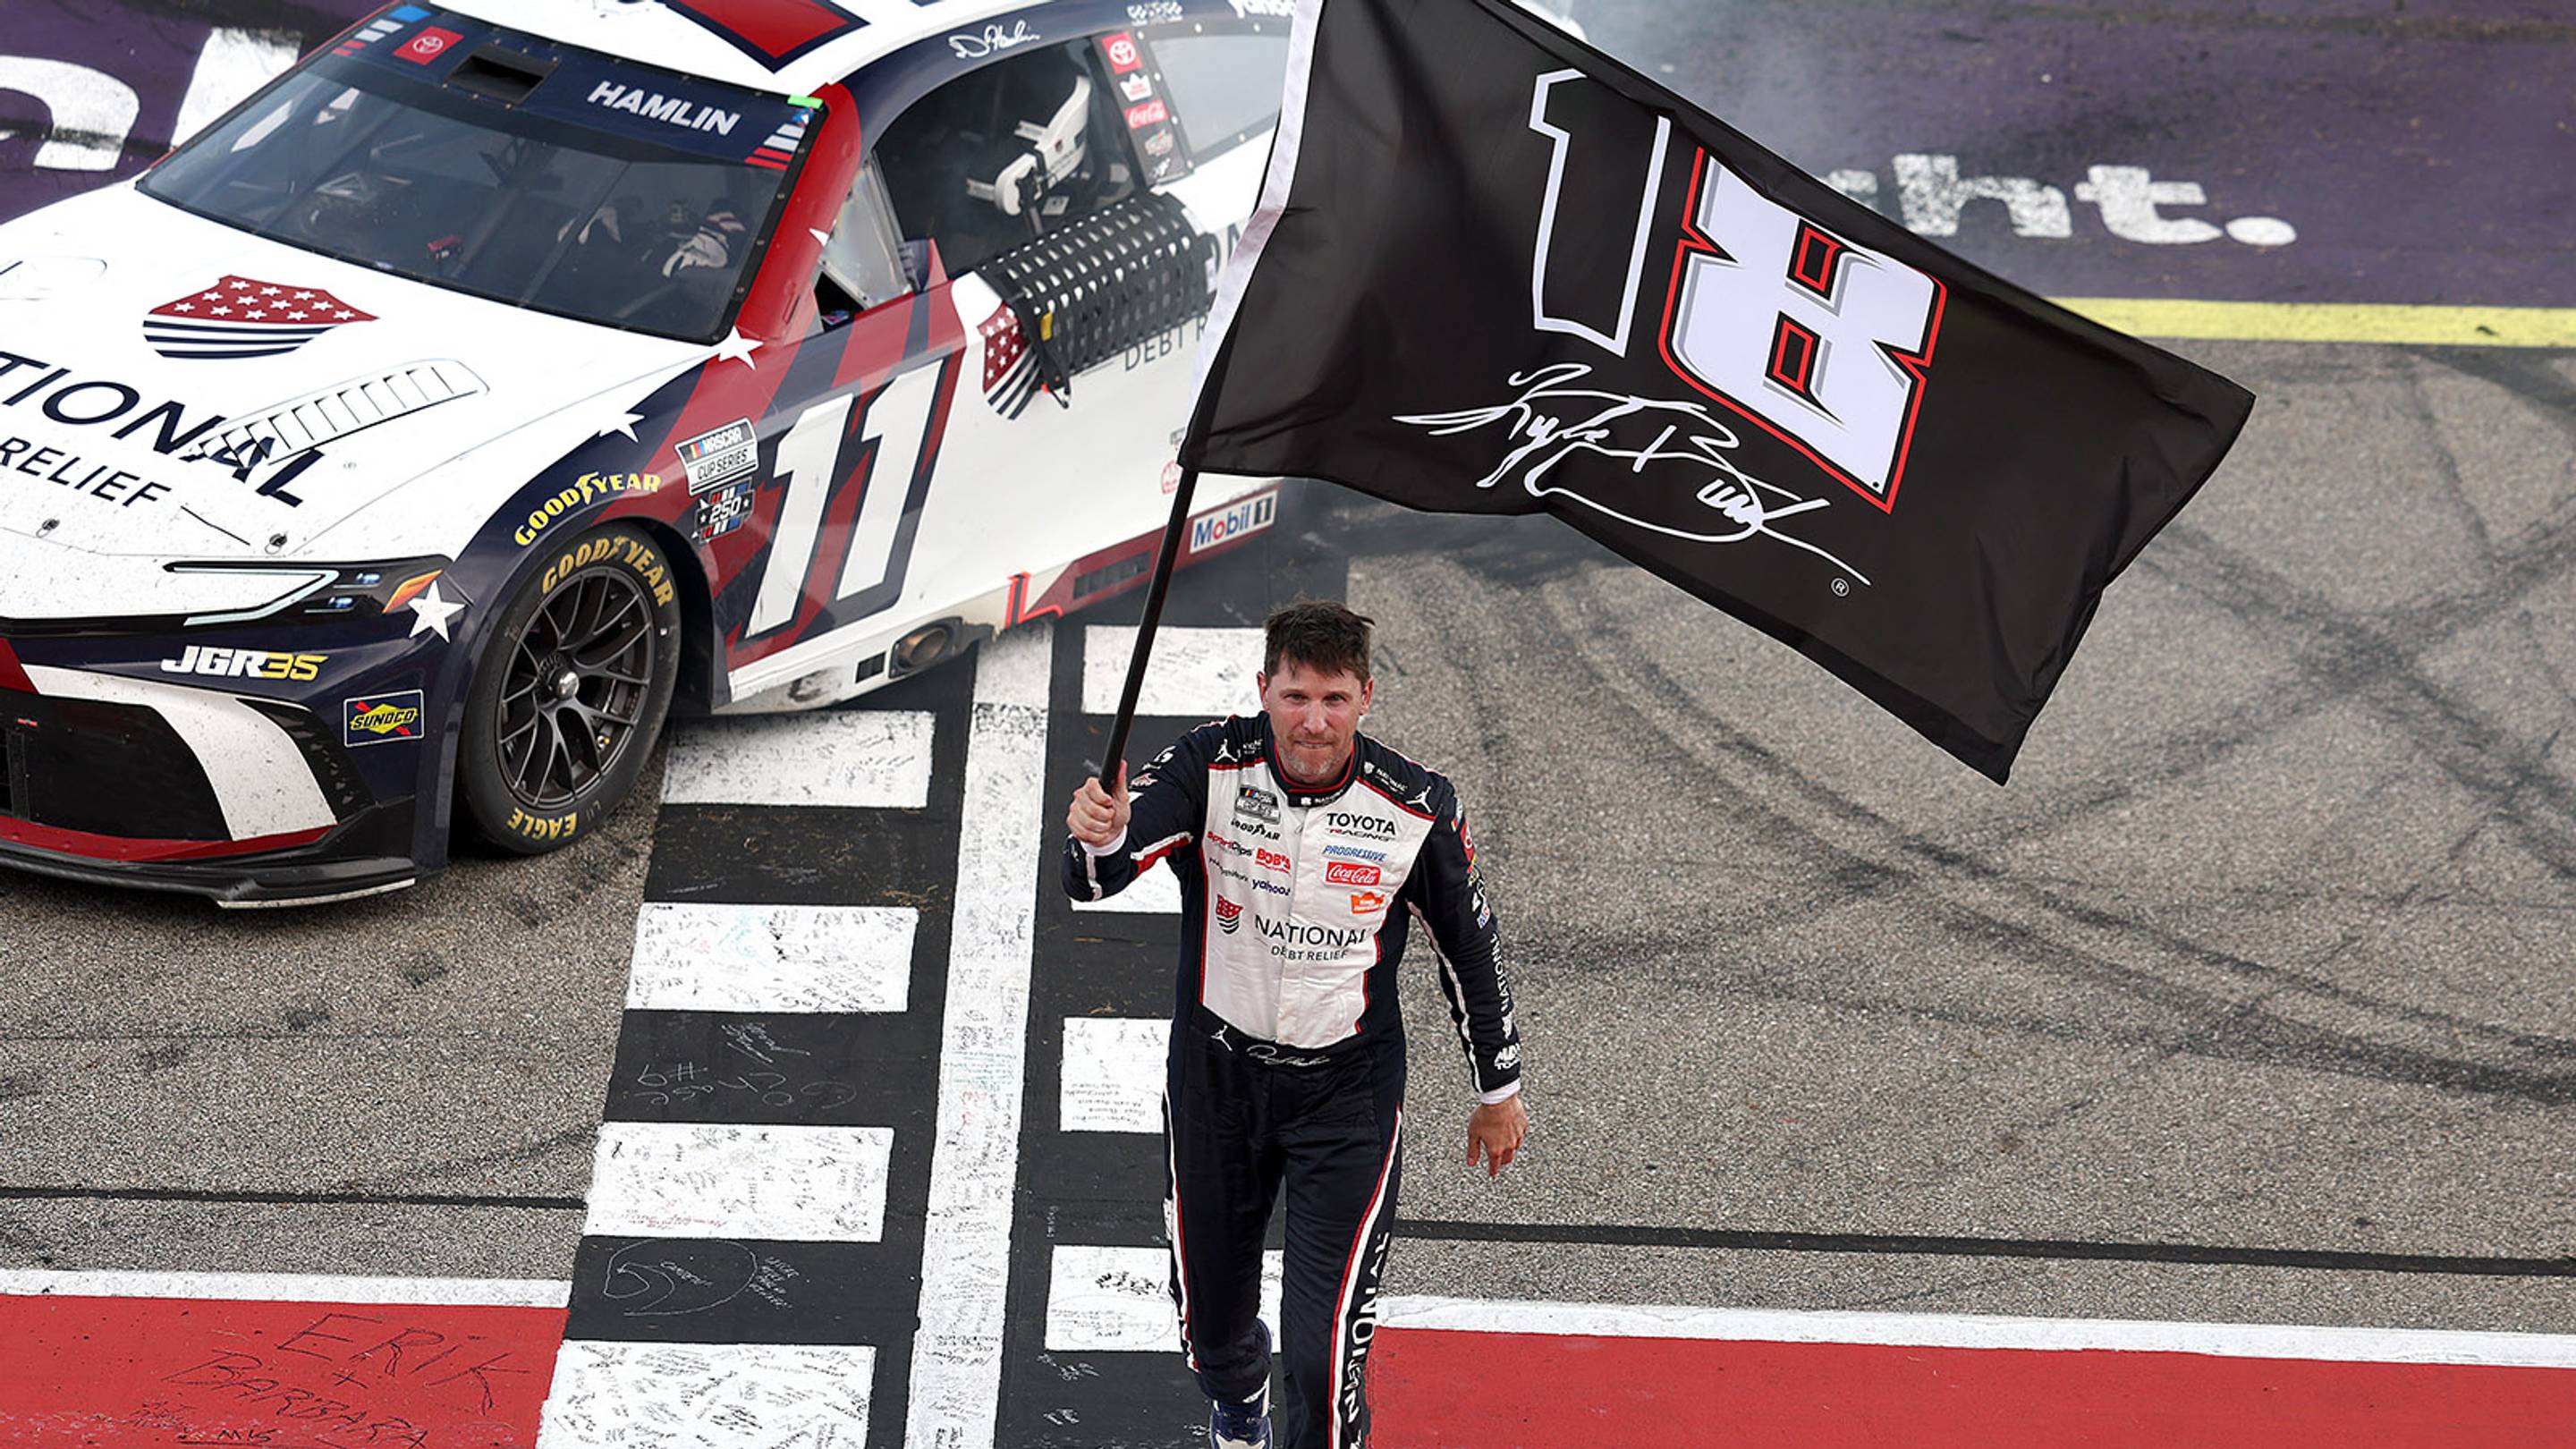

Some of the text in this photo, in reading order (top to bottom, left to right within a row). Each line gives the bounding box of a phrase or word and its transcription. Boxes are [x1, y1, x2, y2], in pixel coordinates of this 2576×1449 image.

[588, 80, 740, 137] HAMLIN
[1528, 68, 1947, 514] 18
[702, 426, 743, 454] NASCAR
[0, 436, 172, 507] RELIEF
[698, 448, 748, 480] CUP SERIES
[514, 471, 662, 547] GOODYEAR
[709, 496, 742, 523] 250
[744, 359, 944, 640] 11
[1193, 496, 1274, 548] Mobil 1
[542, 536, 675, 607] GOODYEAR
[352, 709, 417, 730] SUNOCO
[506, 807, 578, 841] EAGLE
[1326, 812, 1395, 836] TOYOTA
[1322, 845, 1388, 862] PROGRESSIVE
[1270, 945, 1349, 962] DEBT RELIEF
[275, 1313, 531, 1416] ERIK
